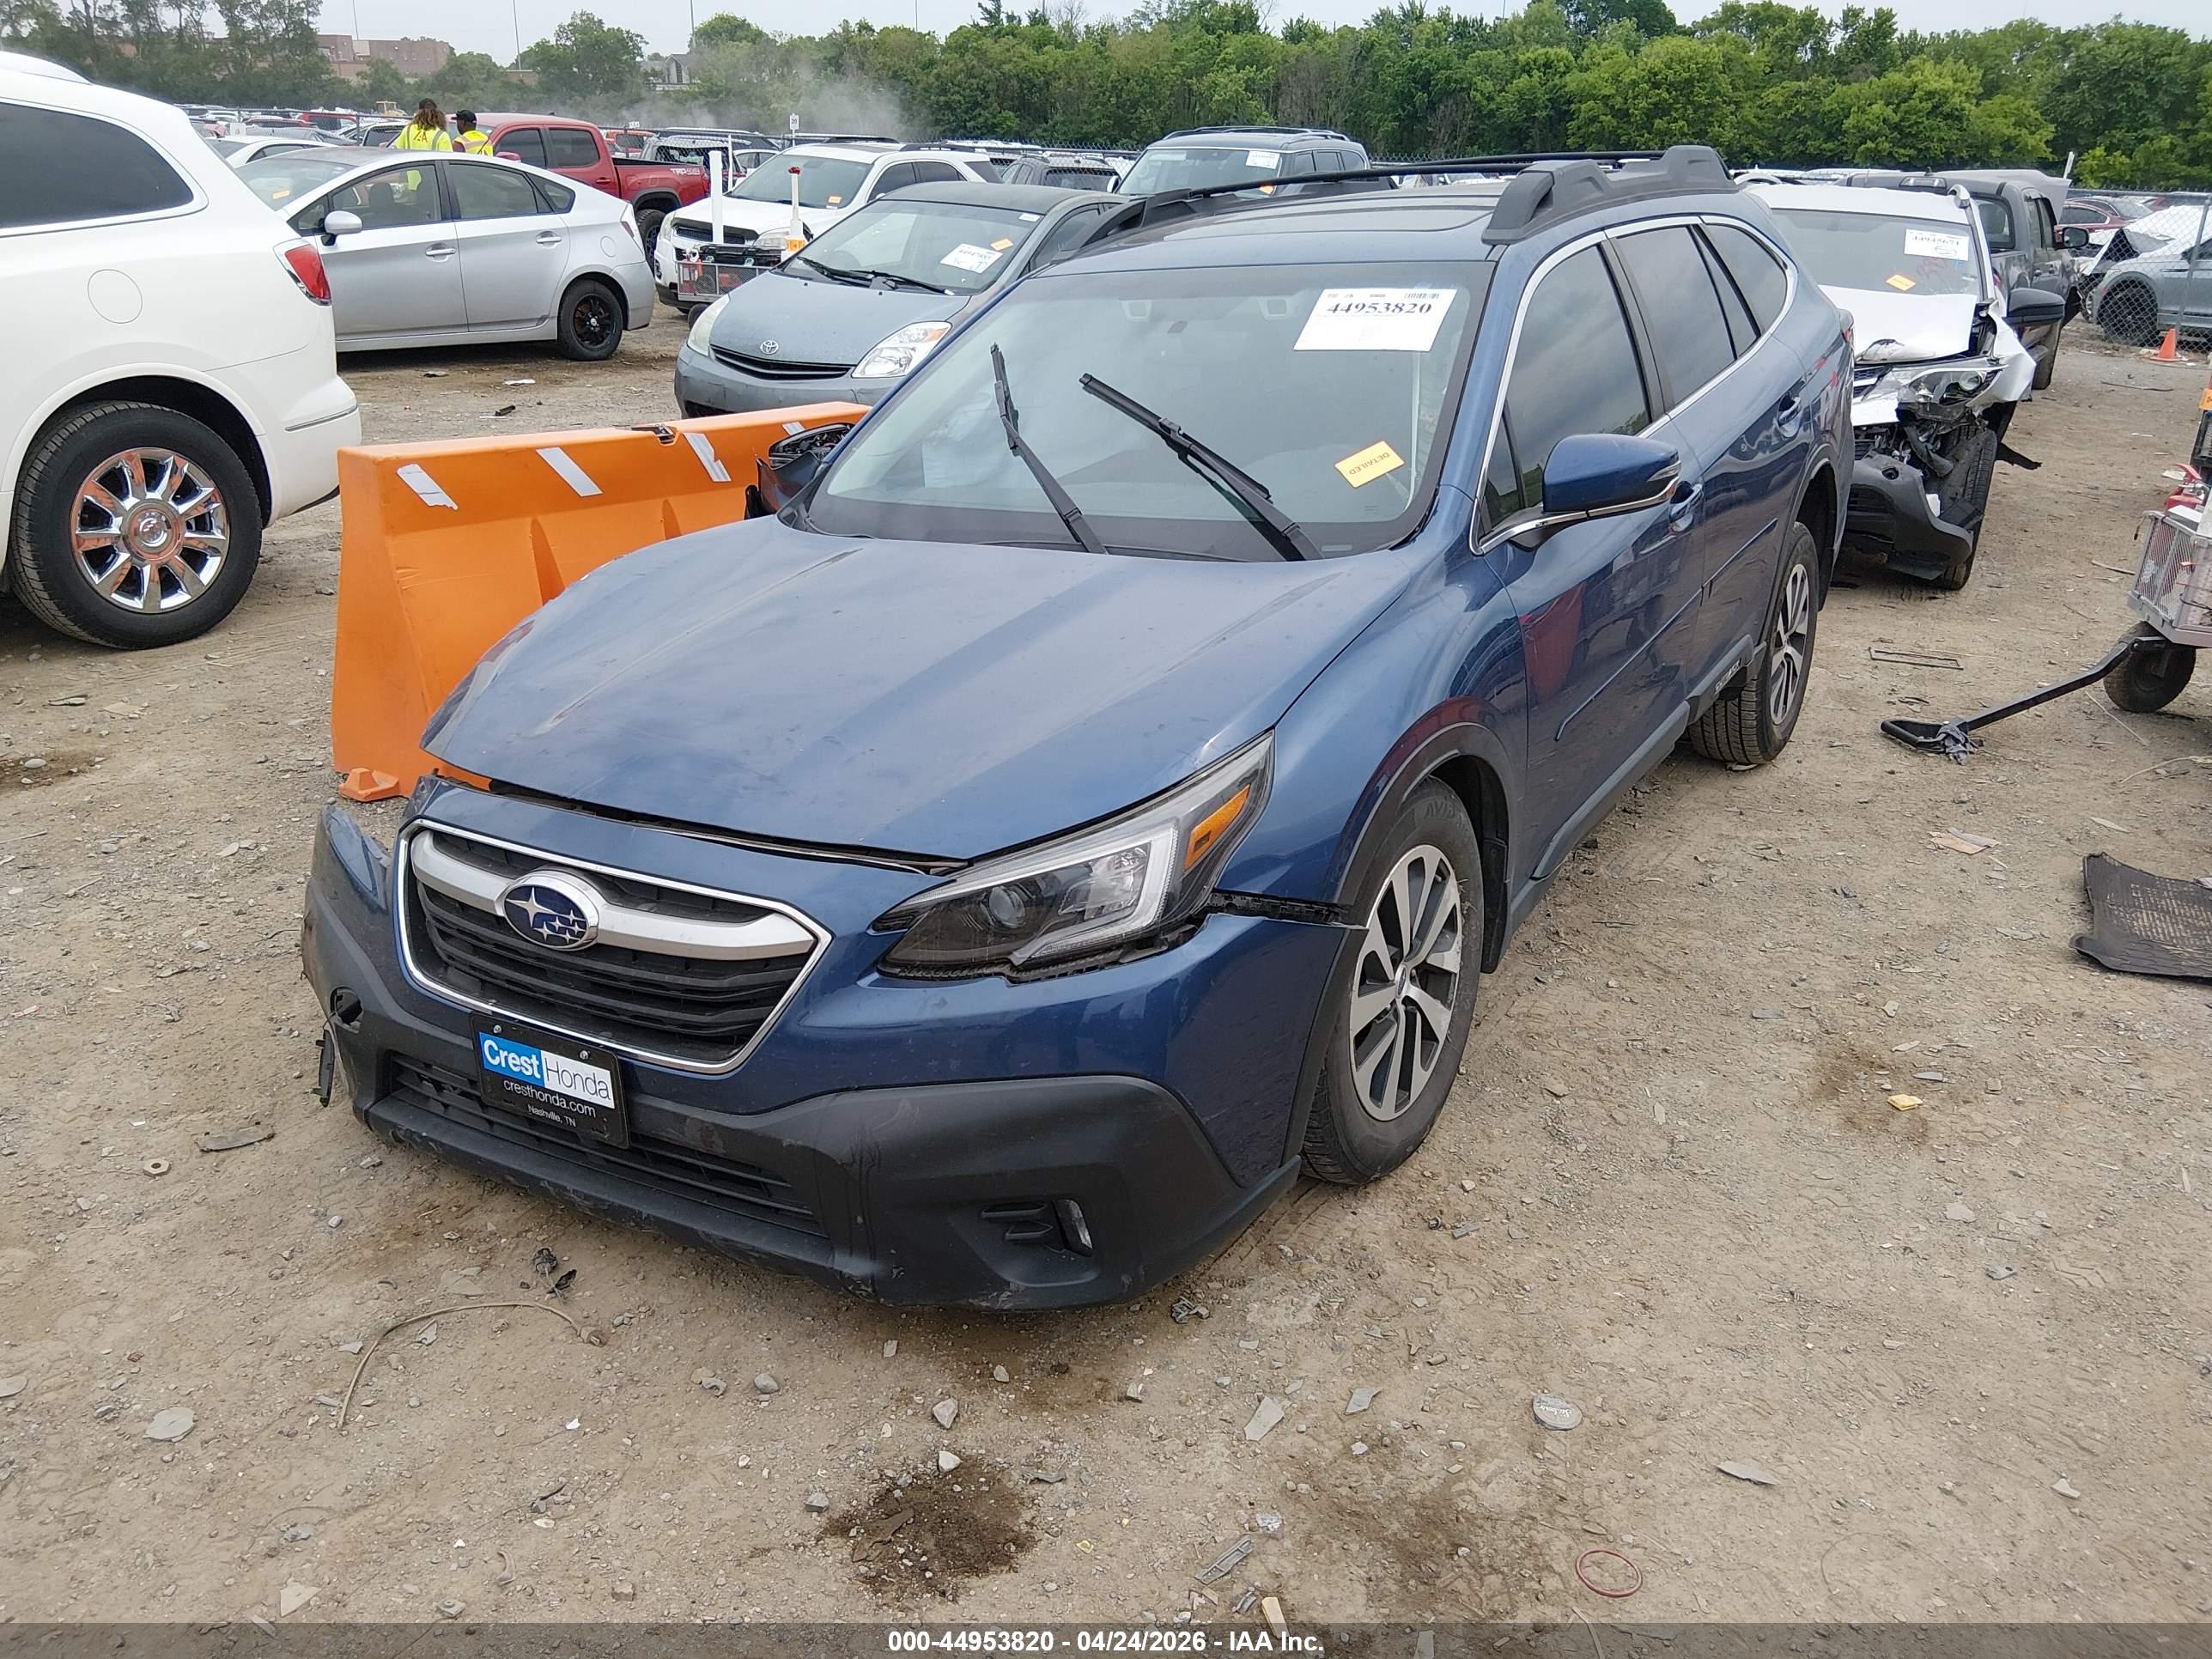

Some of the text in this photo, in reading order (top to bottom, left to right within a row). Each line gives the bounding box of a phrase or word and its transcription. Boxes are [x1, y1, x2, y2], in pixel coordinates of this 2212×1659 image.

[1327, 302, 1433, 314] 44953820
[1349, 452, 1390, 475] DETAILED
[483, 1039, 611, 1100] Crest Honda
[503, 1079, 597, 1118] cresthonda.com
[527, 1104, 577, 1128] Nashville, TN
